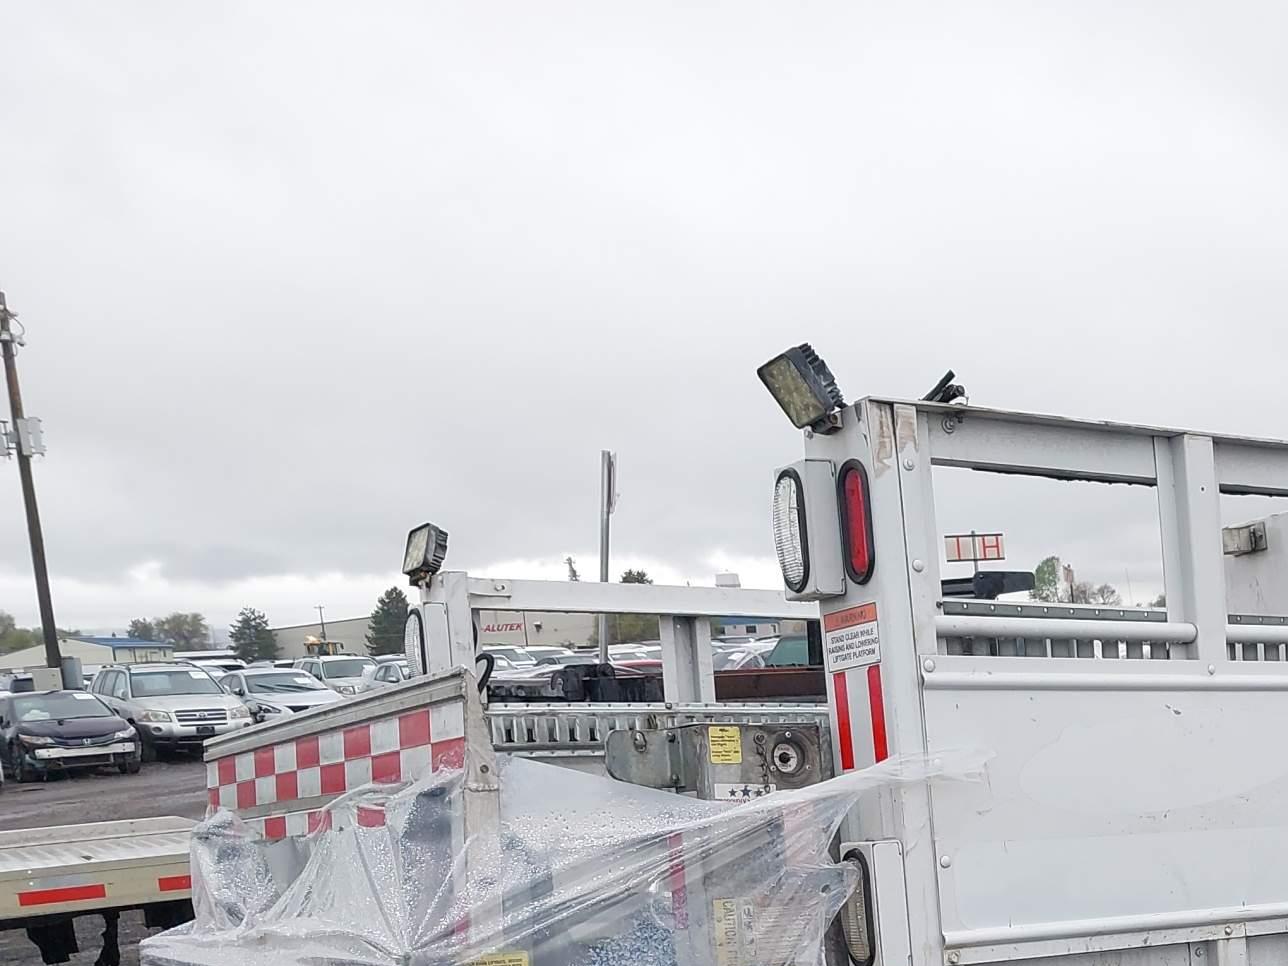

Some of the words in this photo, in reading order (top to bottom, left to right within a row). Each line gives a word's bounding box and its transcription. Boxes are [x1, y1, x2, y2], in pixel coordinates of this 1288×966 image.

[483, 623, 523, 633] ALUTEK
[831, 635, 845, 645] STAND
[845, 631, 860, 641] CLEAR
[860, 627, 874, 638] WHILE
[828, 645, 846, 655] RAISING
[846, 642, 854, 651] AND
[855, 637, 879, 649] LOWERING
[832, 652, 852, 664] LIFTGATE
[852, 647, 876, 659] PLATFORM
